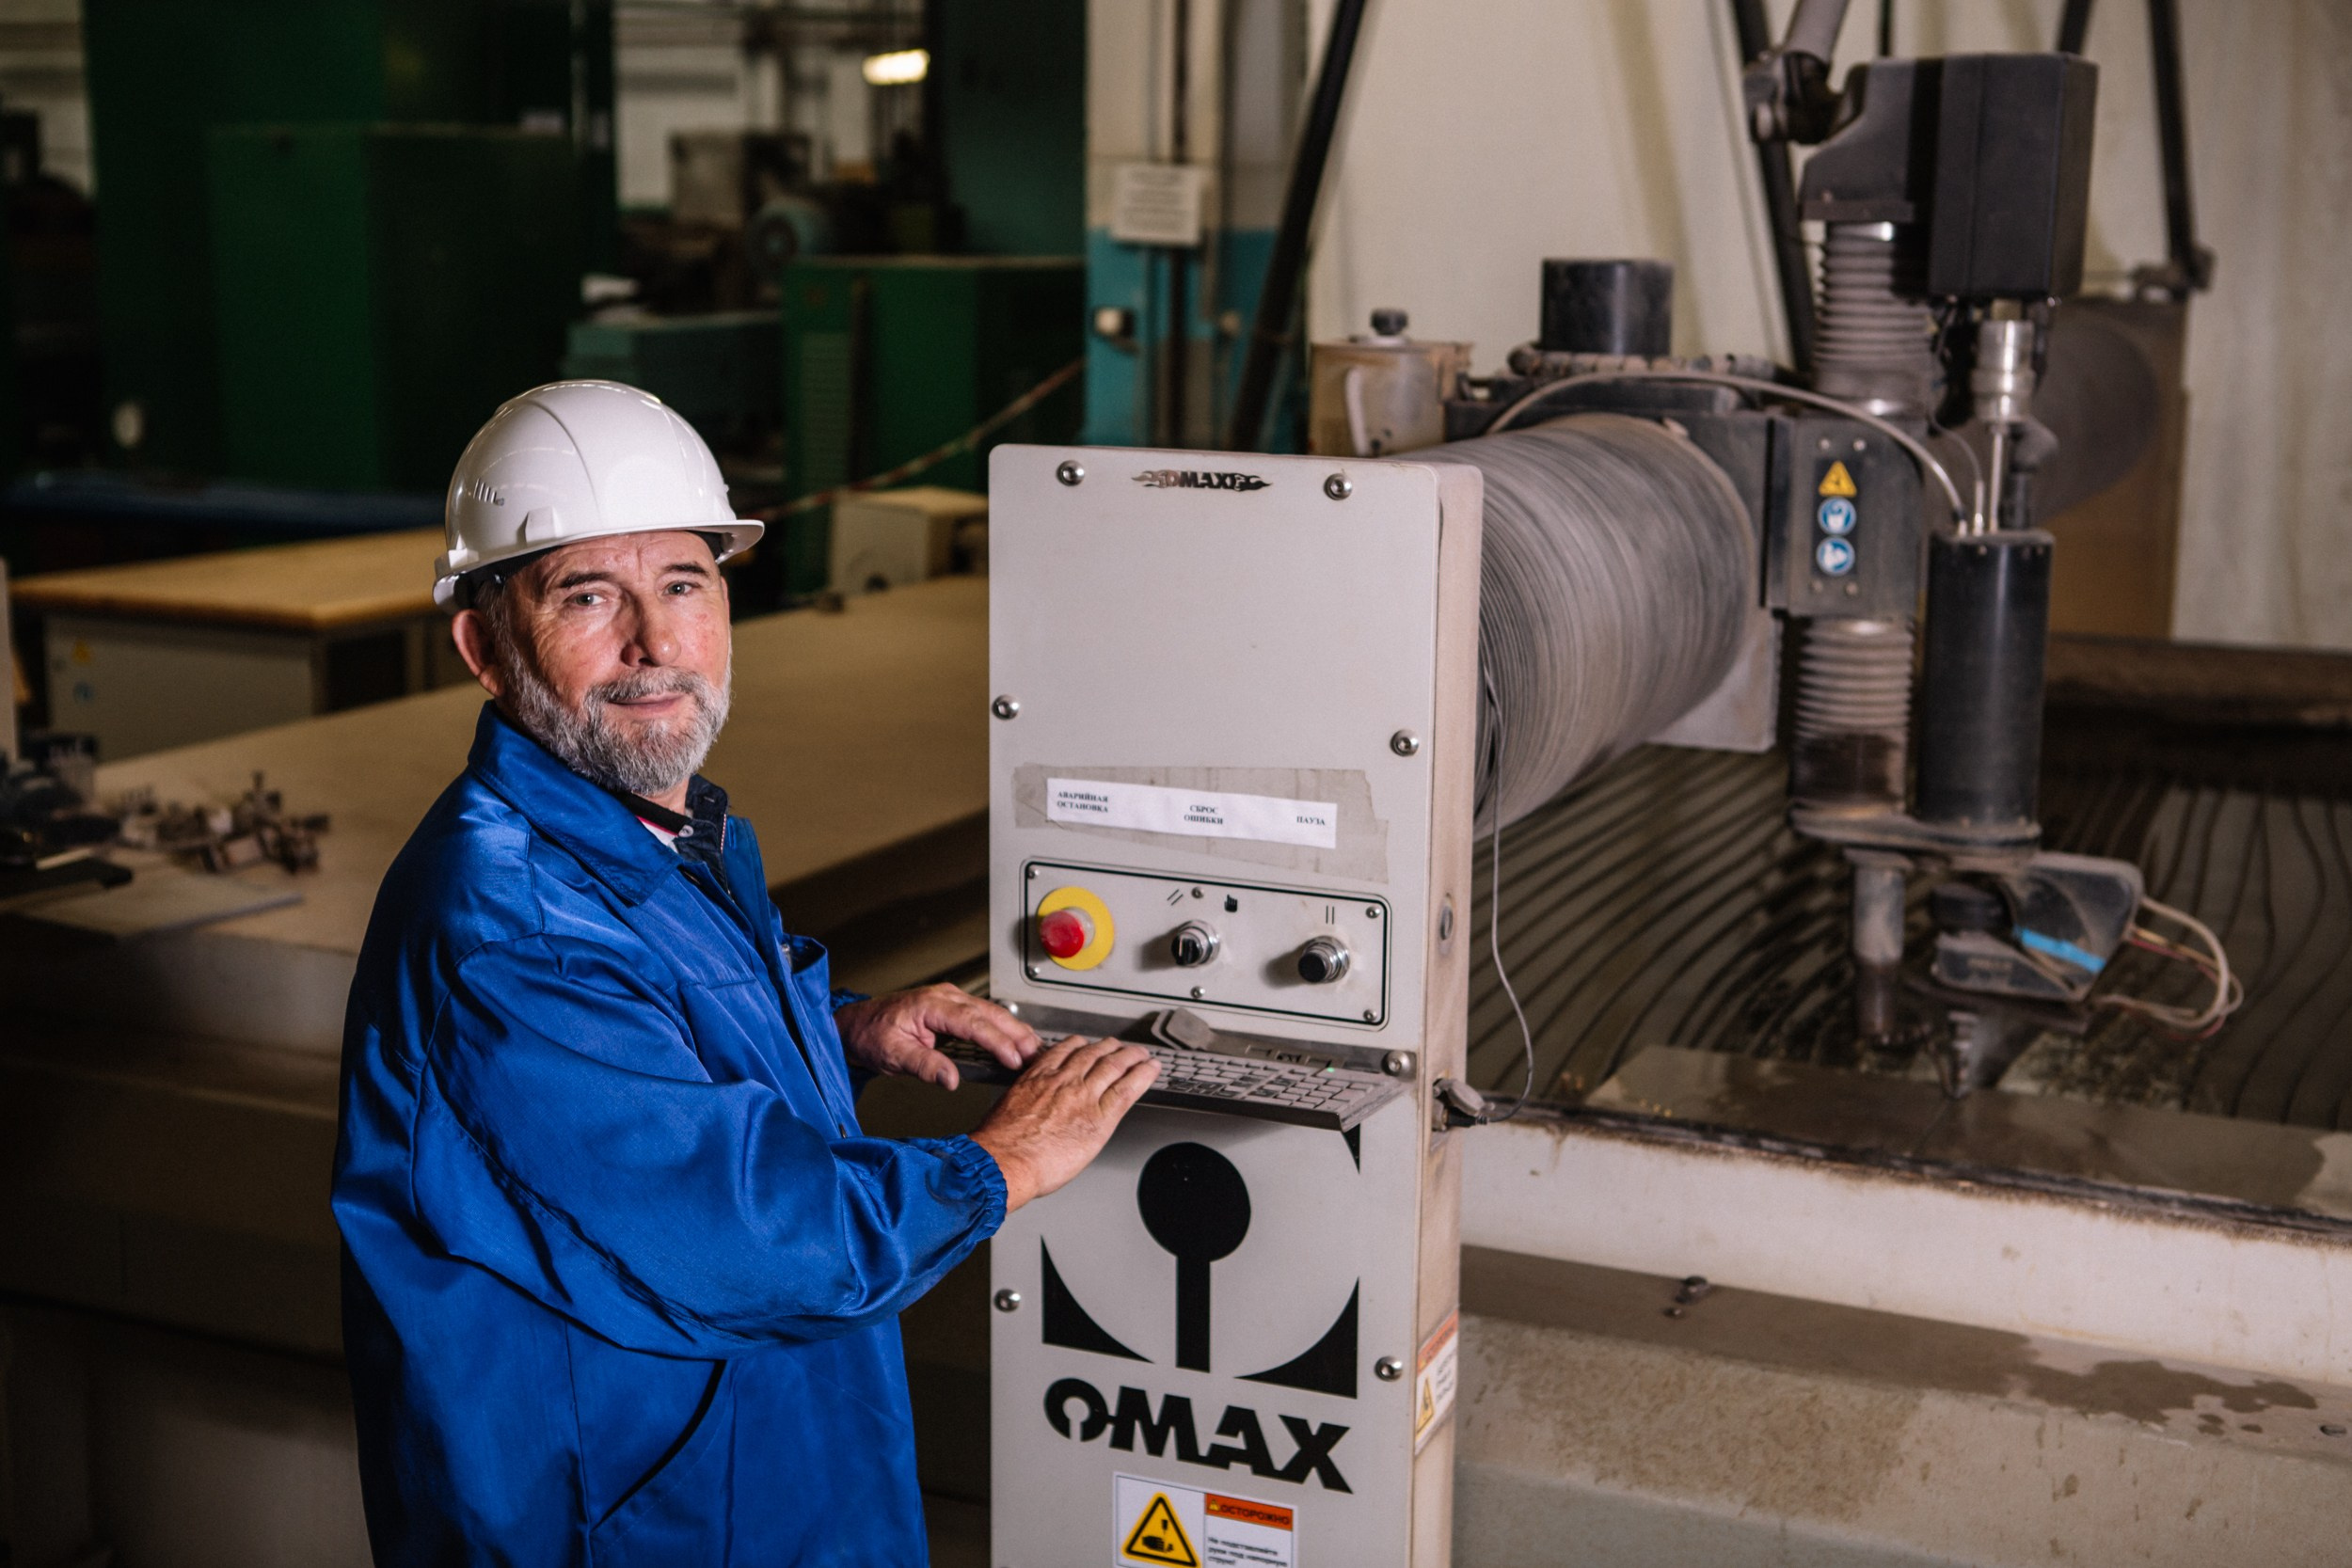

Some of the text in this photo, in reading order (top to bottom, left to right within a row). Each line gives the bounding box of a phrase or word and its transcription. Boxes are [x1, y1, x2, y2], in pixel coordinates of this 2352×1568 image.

[1057, 791, 1108, 802] АВАРИЙНАЯ
[1057, 800, 1108, 813] ОСТАНОВКА
[1189, 804, 1219, 815] СБРОС
[1184, 815, 1224, 825] ОШИБКИ
[1296, 816, 1326, 826] ПАУЗА
[1043, 1378, 1354, 1494] OMAX
[1220, 1505, 1290, 1526] ОСТОРОЖНО
